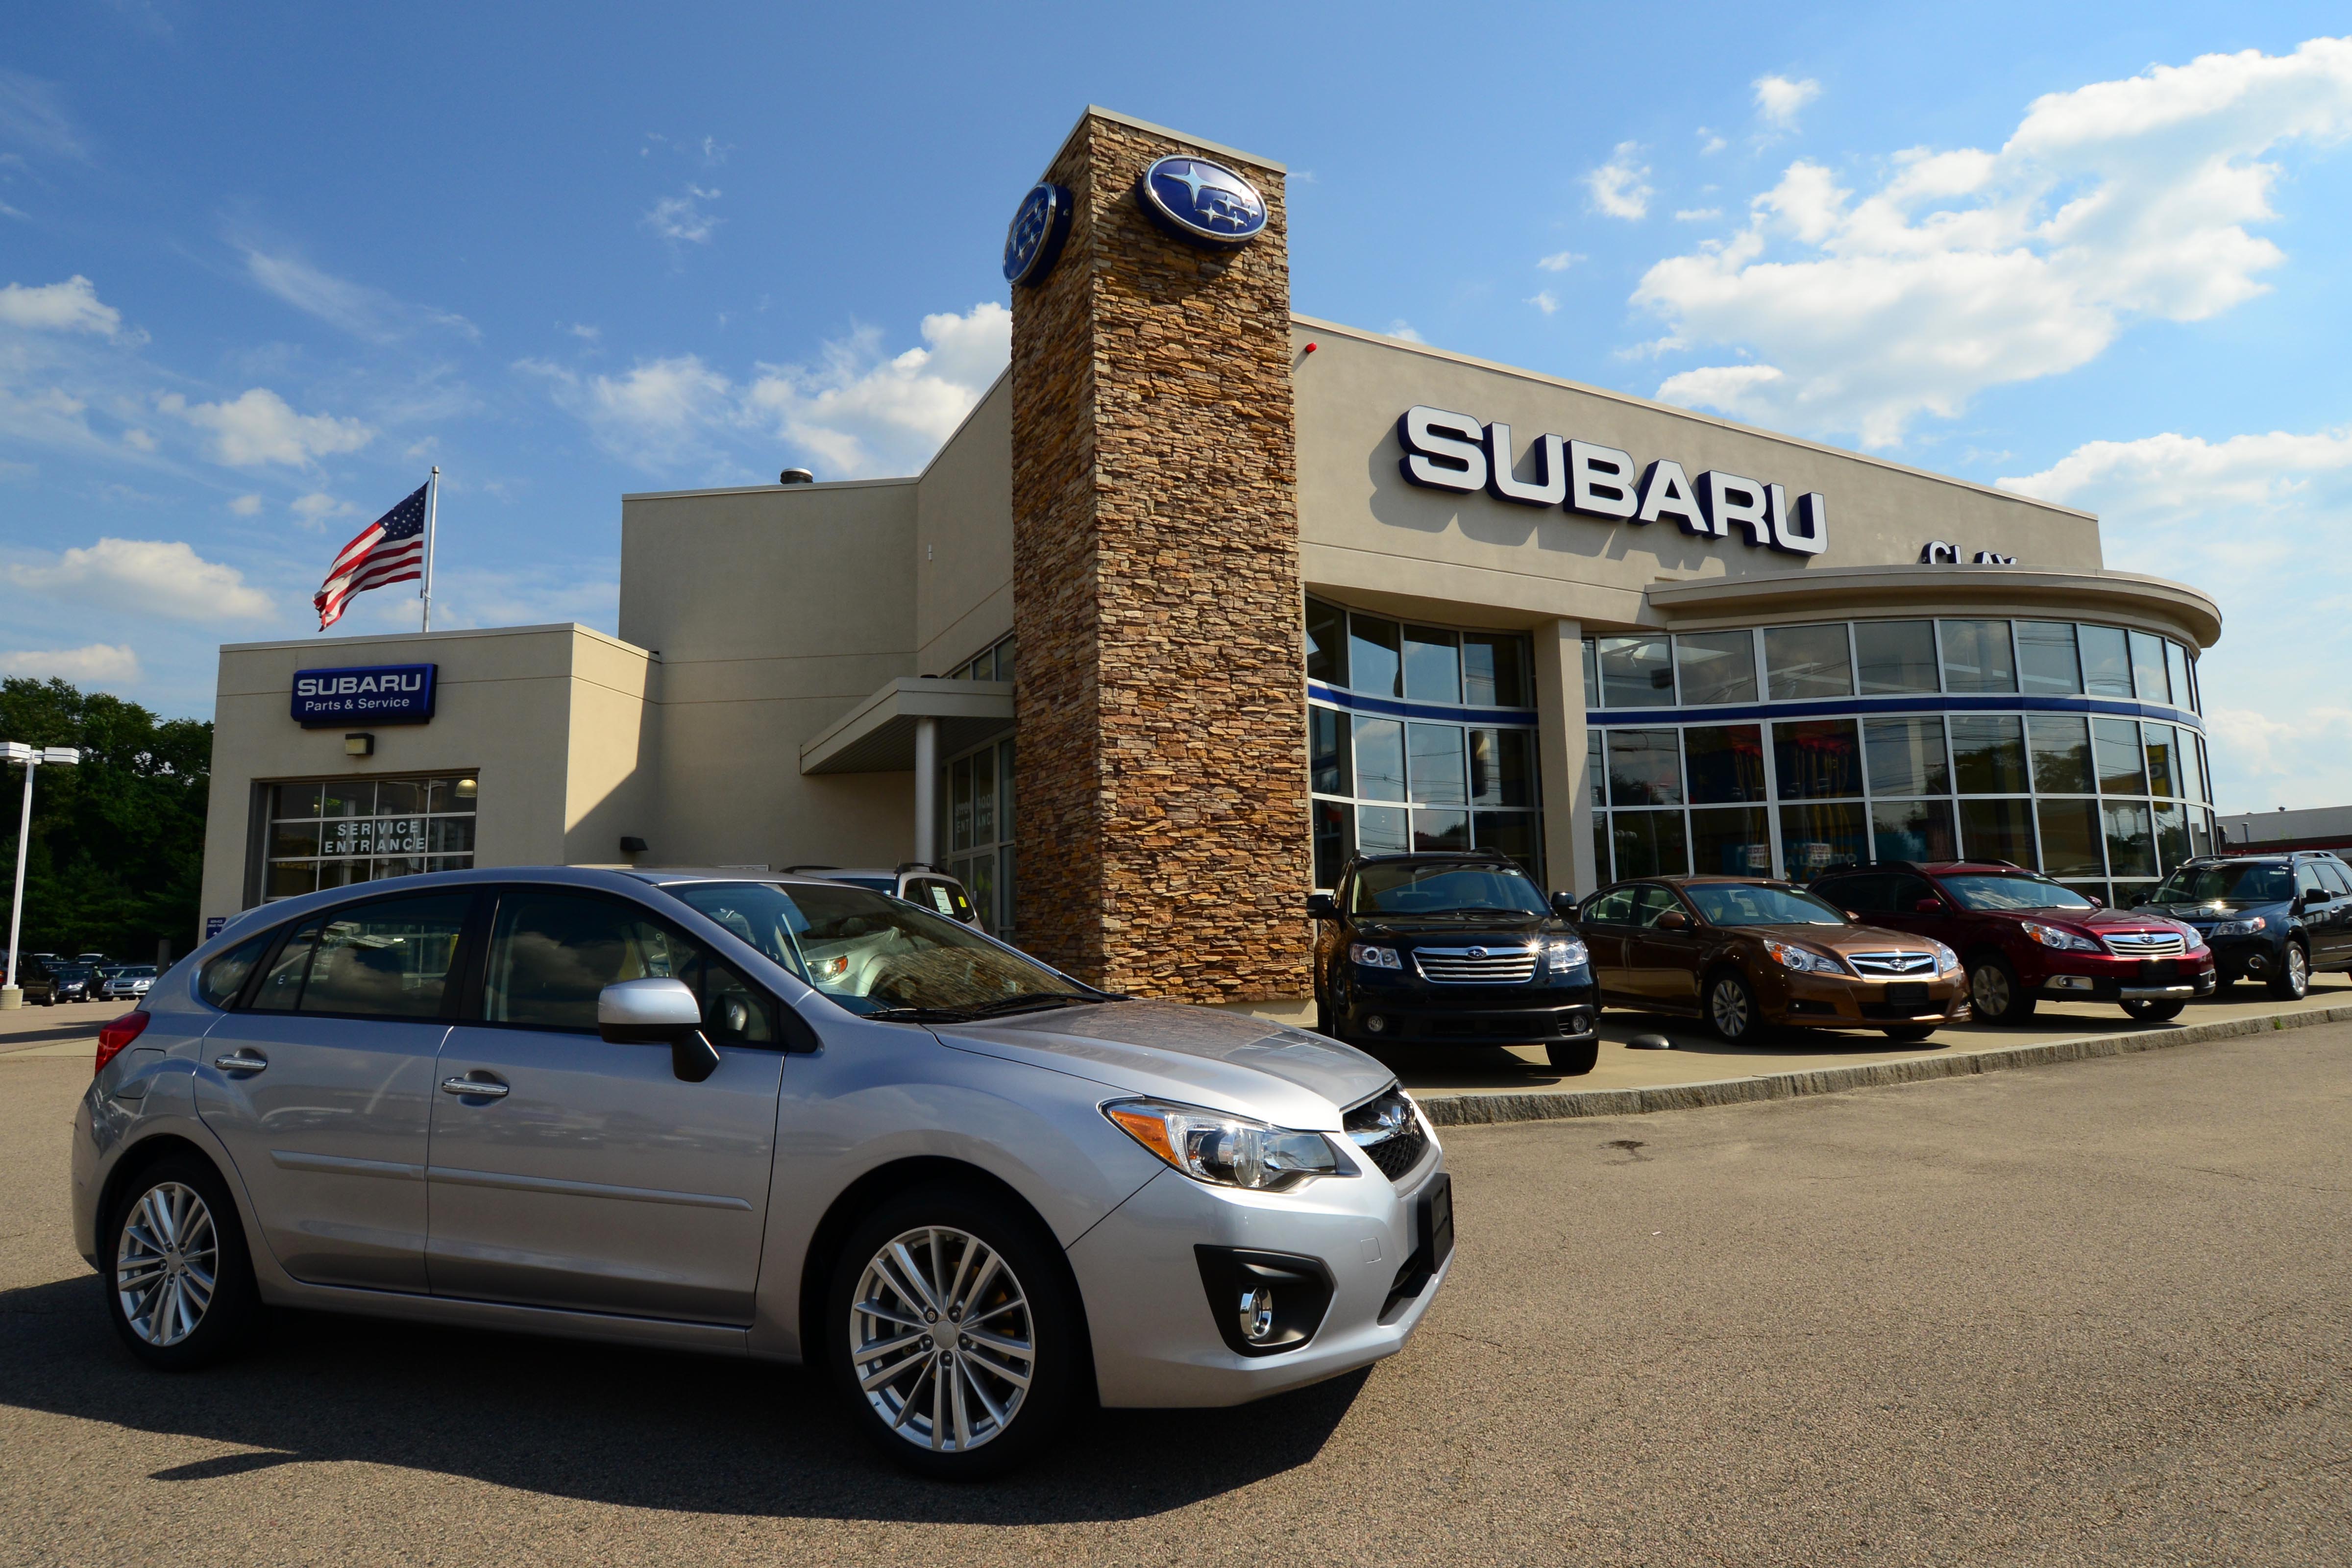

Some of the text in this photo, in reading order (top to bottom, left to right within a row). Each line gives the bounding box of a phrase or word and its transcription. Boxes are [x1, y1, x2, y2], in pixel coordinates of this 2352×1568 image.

[1398, 404, 1829, 557] SUBARU
[1922, 540, 2018, 564] CLA
[297, 674, 421, 696] SUBARU
[305, 697, 410, 711] Parts & Service
[338, 821, 418, 836] SERVICE
[324, 837, 425, 853] ENTRANCE
